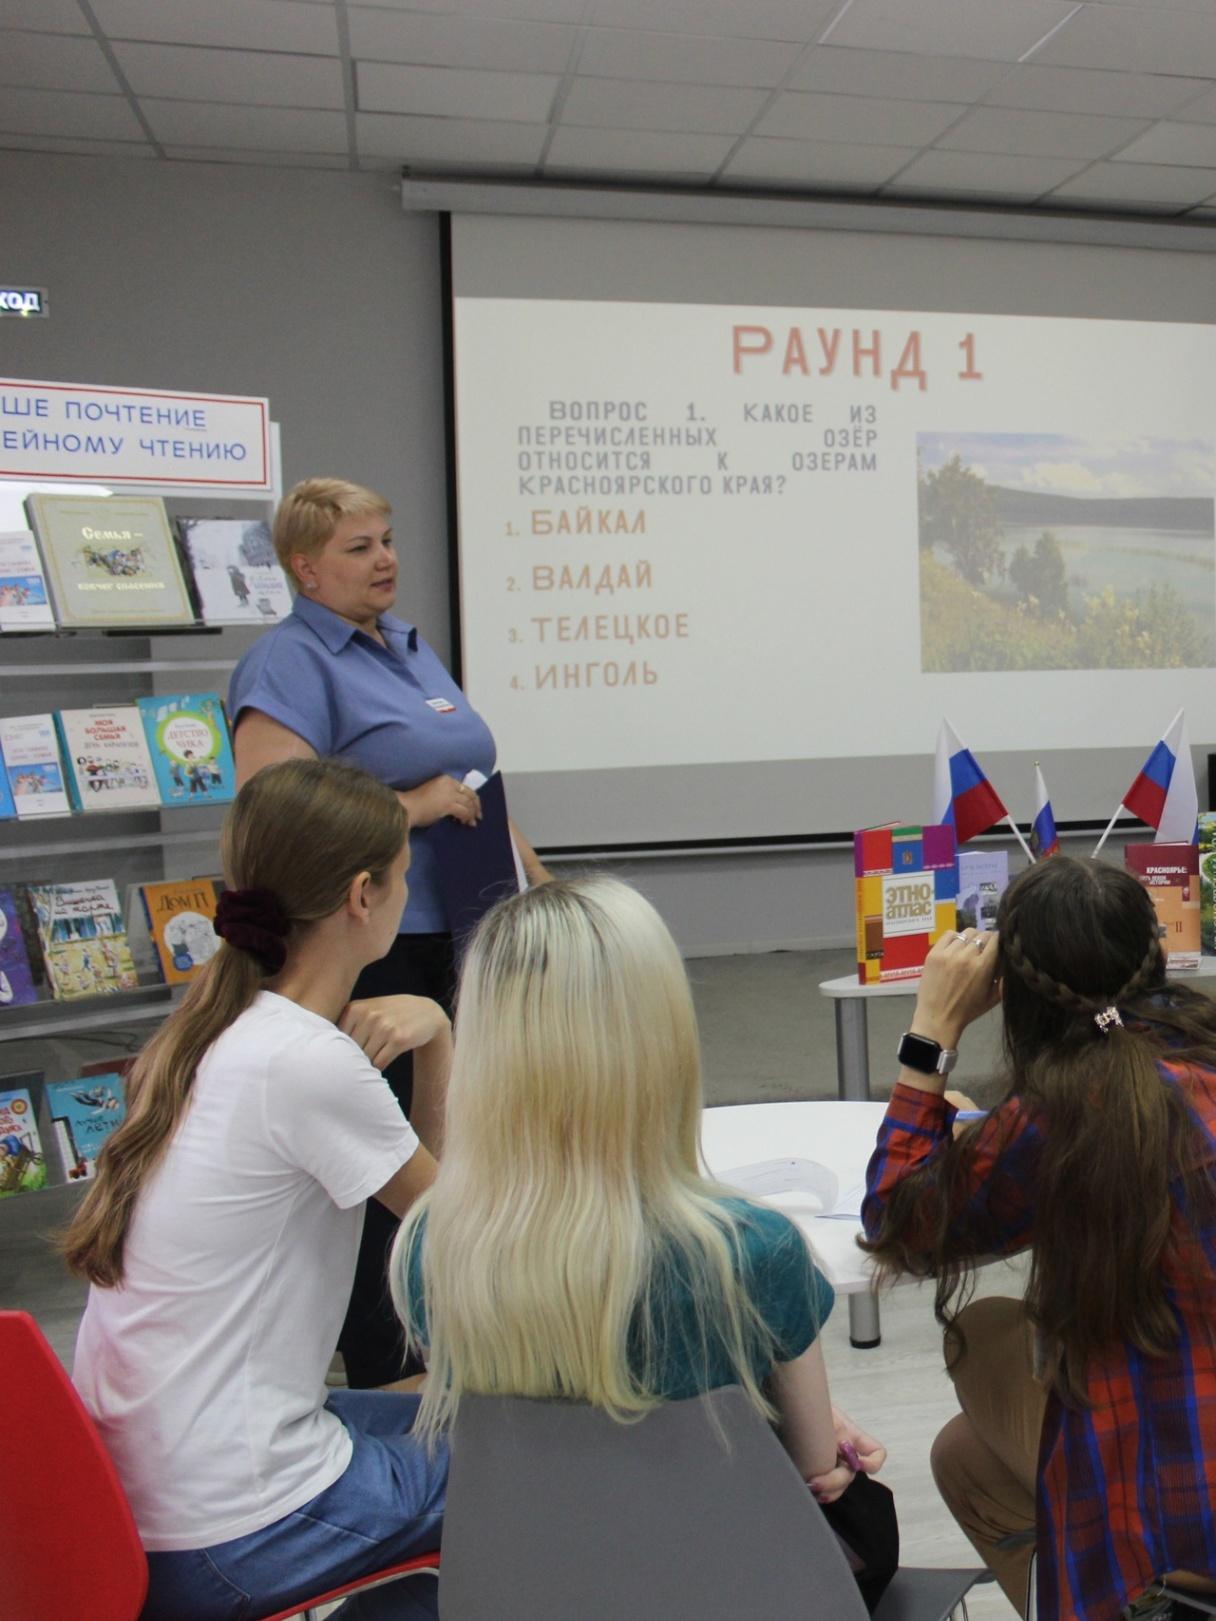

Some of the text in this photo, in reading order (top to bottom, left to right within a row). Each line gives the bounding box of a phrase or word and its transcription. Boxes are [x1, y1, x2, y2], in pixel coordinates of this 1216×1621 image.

[732, 325, 984, 391] РАУНД 1
[65, 401, 206, 428] ПОЧТЕНИЕ
[550, 401, 876, 424] ВОПРОС 1. КАКОЕ ИЗ
[3, 429, 247, 461] ЕЙНОМУ ЧТЕНИЮ
[518, 426, 878, 448] ПЕРЕЧИСЛЕННЫХ ОЗЁР
[518, 451, 877, 471] ОТНОСИТСЯ К ОЗЕРАМ
[519, 475, 787, 495] КРАСНОЯРСКОГО КРАЯ?
[504, 505, 646, 536] 1. БАЙКАЛ
[506, 559, 653, 595] 2. ВАЛДАЙ
[508, 613, 689, 645] 3. ТЕЛЕЦКОЕ
[510, 661, 658, 690] 4. ИНГОЛЬ
